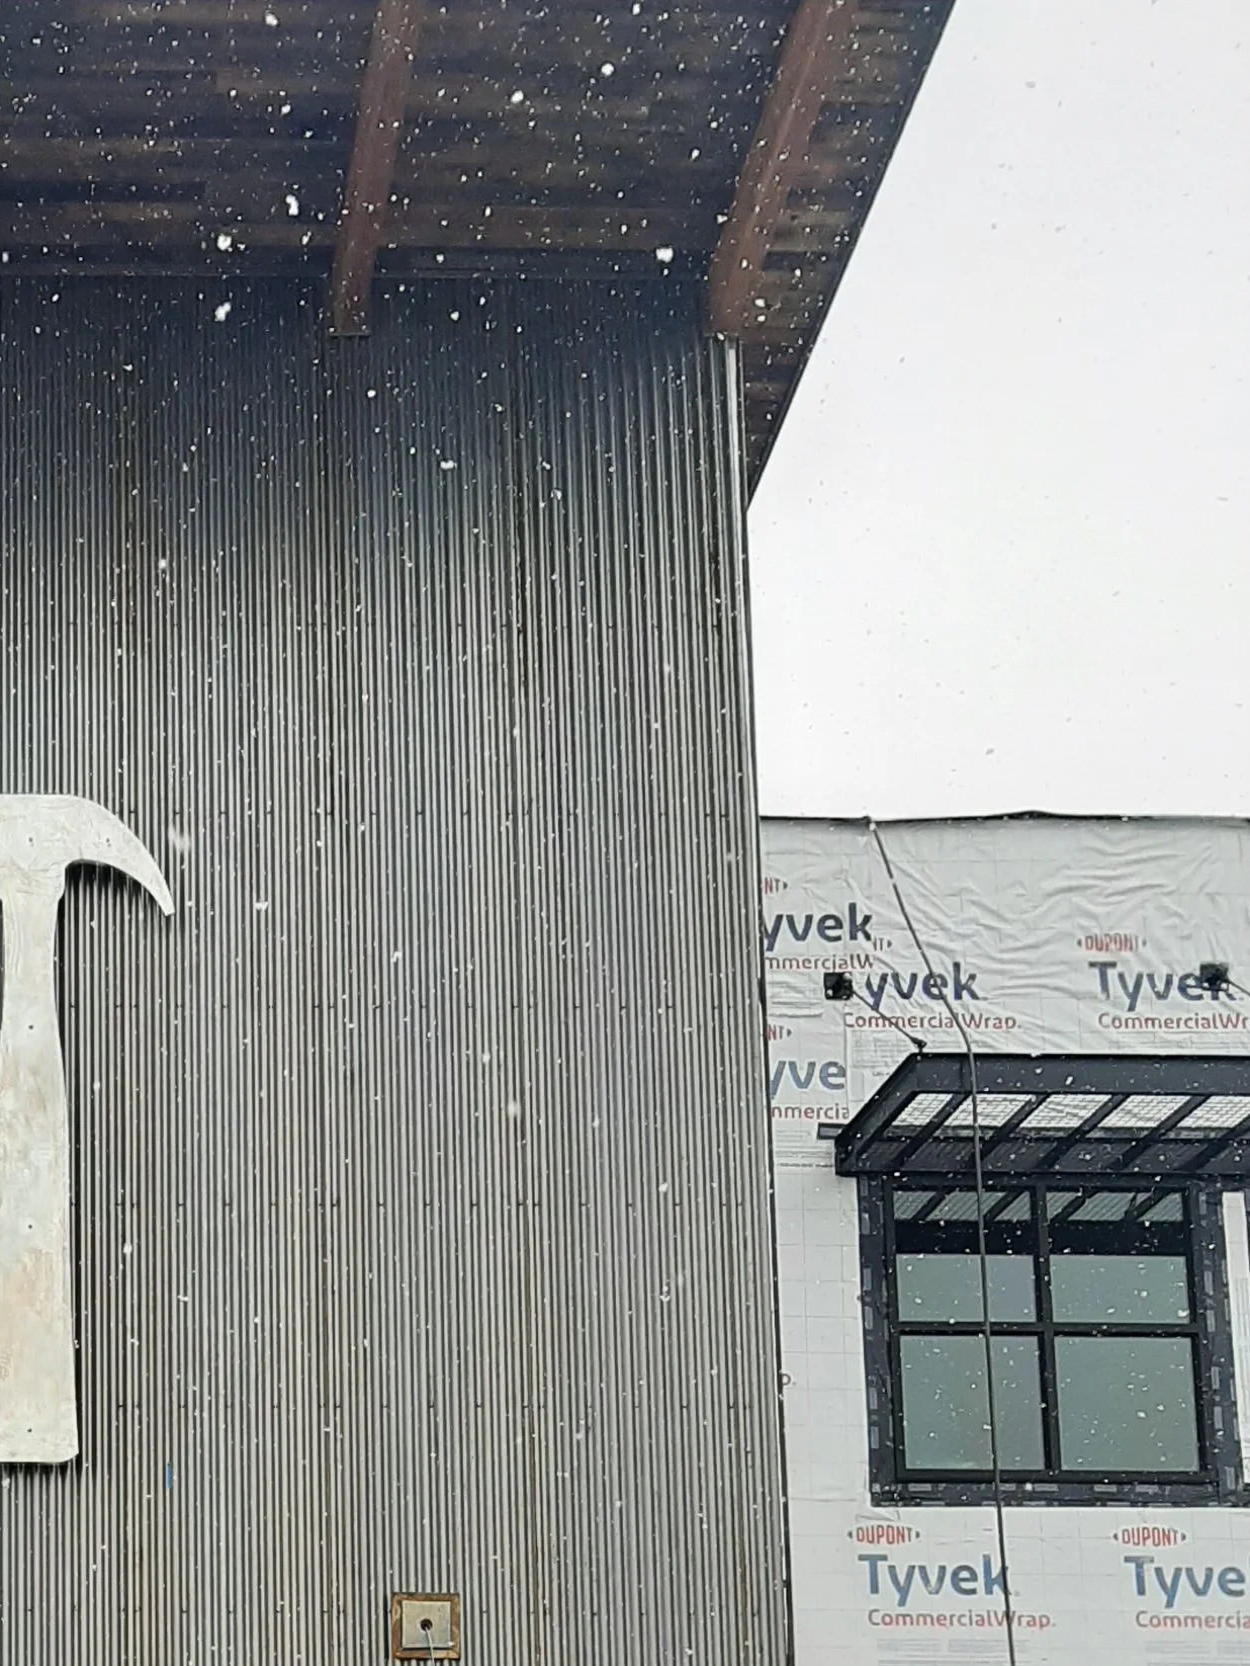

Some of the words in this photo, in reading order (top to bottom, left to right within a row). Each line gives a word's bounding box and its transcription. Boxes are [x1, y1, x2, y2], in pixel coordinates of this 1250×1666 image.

[856, 1525, 913, 1545] DUPONT
[1121, 1527, 1179, 1547] DUPONT
[1123, 1555, 1250, 1609] Tyve
